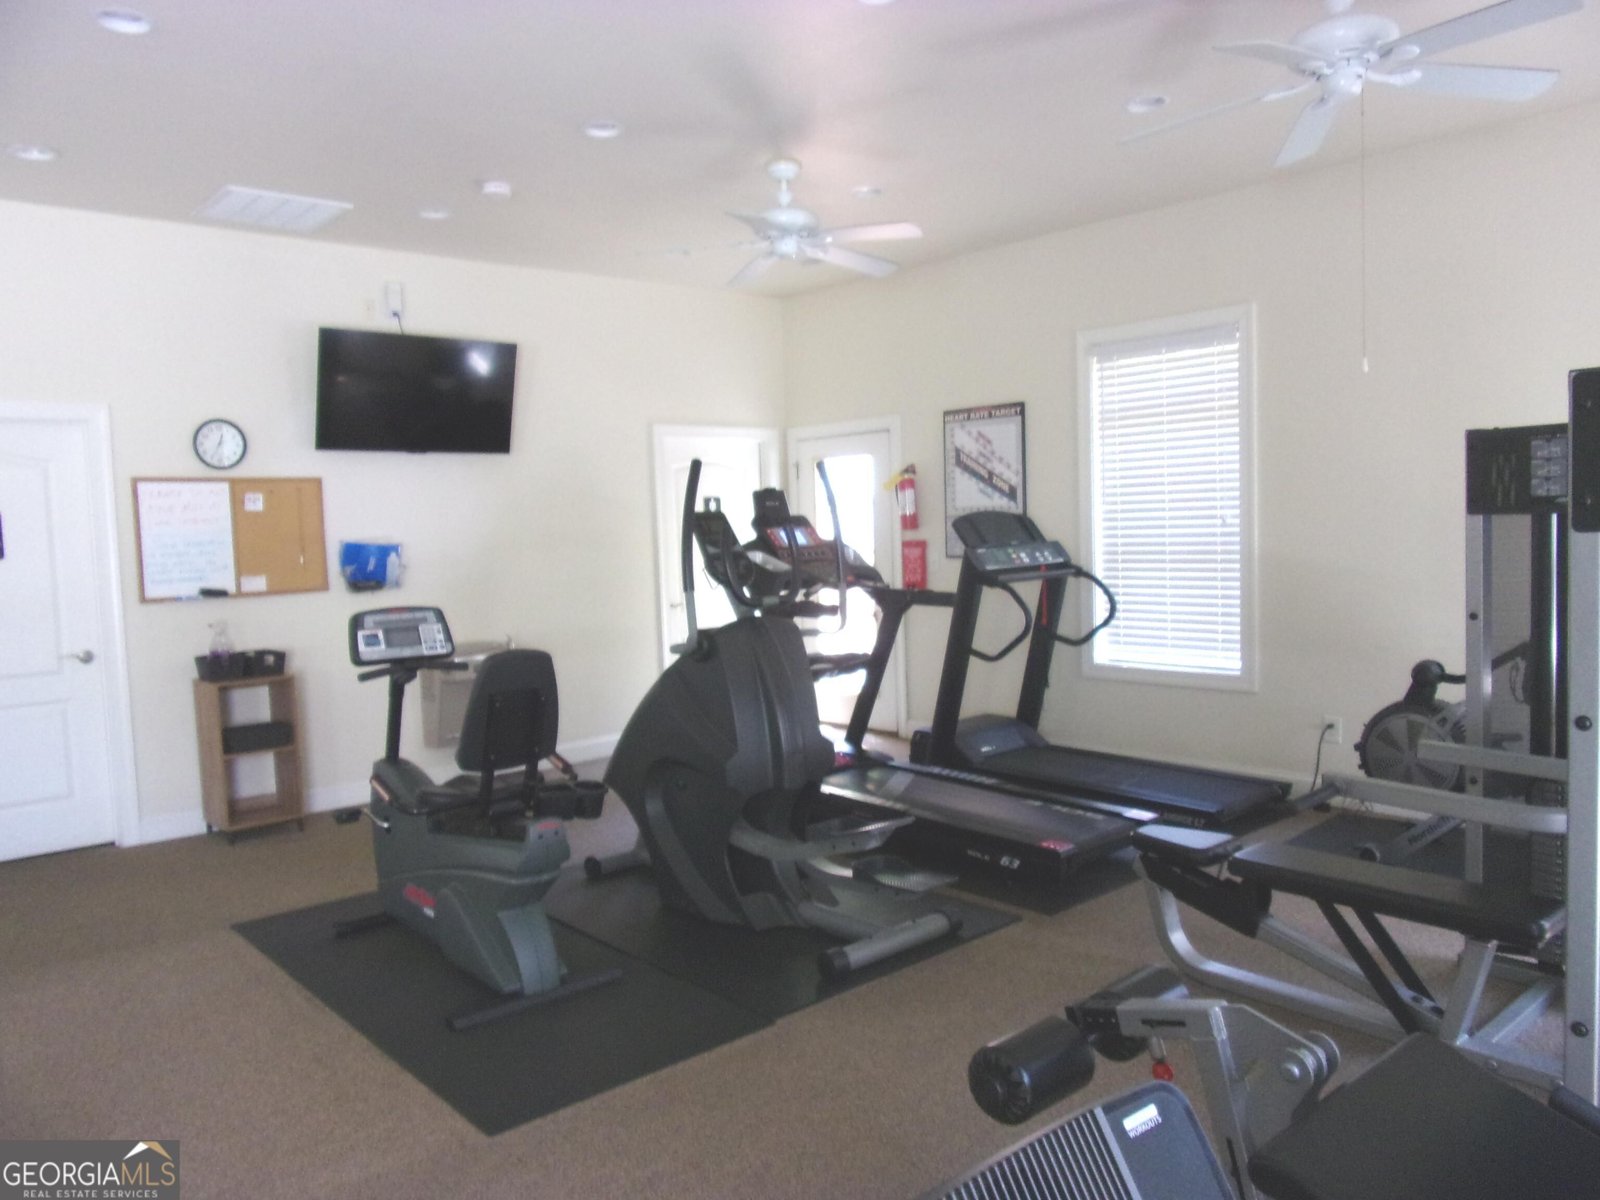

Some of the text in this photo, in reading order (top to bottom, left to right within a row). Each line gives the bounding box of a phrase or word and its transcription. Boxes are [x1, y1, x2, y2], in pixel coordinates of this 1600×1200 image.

[944, 406, 1021, 422] HEART RATE TARGET
[1127, 1114, 1162, 1139] WORKOUTS
